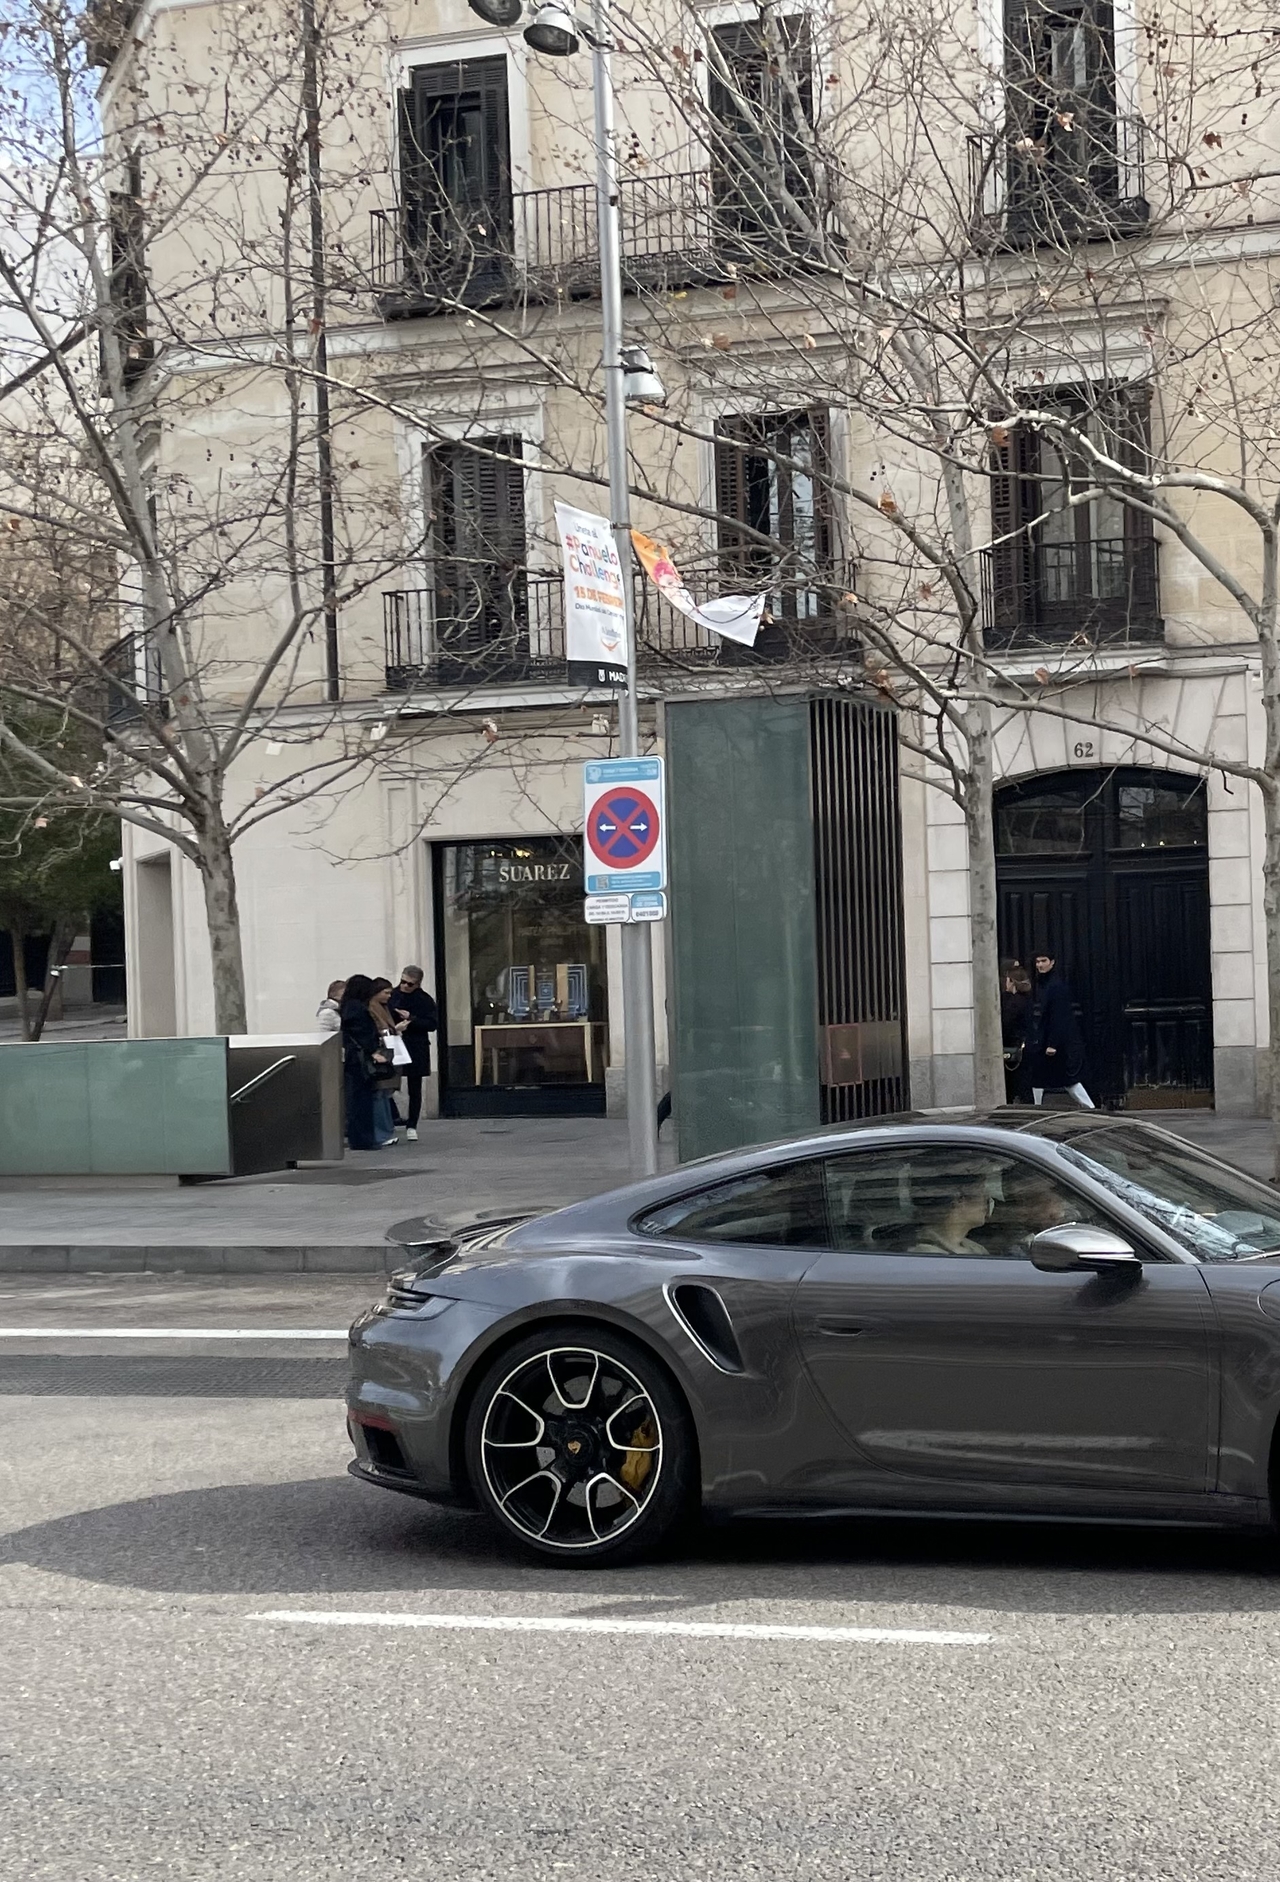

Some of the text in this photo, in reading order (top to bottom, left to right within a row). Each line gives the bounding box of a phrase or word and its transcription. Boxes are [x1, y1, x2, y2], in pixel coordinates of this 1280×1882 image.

[574, 585, 586, 599] 15
[1074, 741, 1094, 758] 62
[499, 863, 571, 883] SUAREZ
